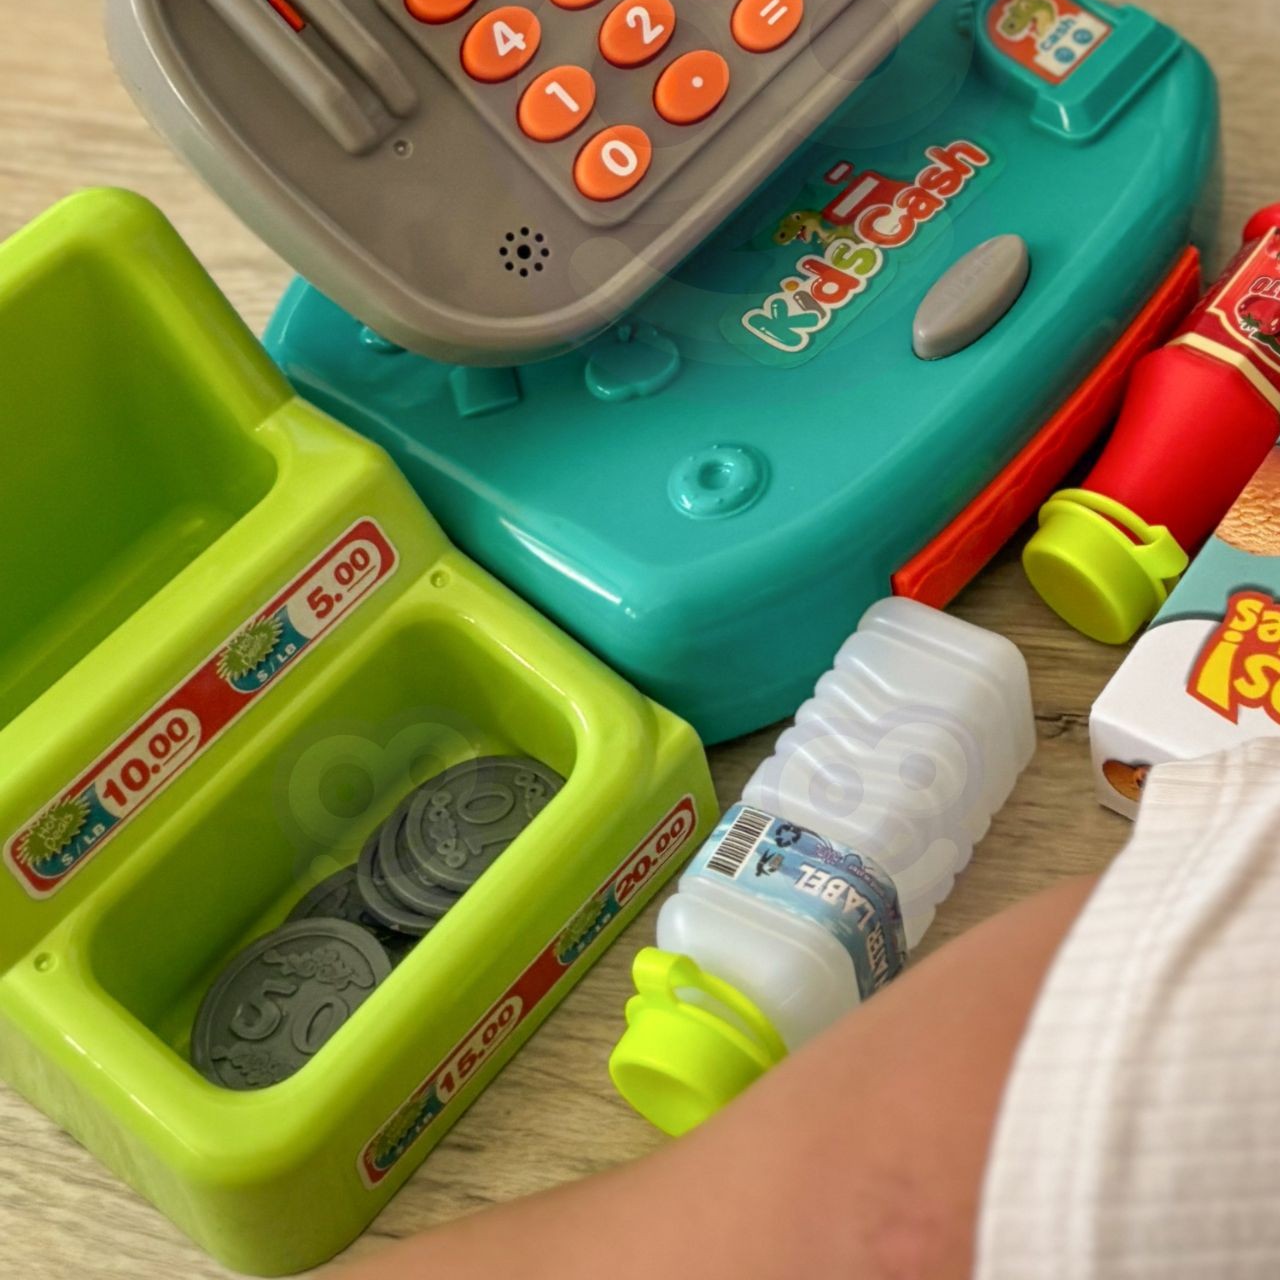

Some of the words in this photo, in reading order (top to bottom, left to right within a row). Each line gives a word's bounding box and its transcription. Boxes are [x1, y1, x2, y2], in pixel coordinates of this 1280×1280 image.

[492, 20, 527, 58] 4
[625, 6, 665, 46] 2
[1040, 19, 1077, 51] cash
[544, 81, 580, 113] 1
[600, 139, 638, 178] 0
[306, 547, 370, 620] 5.00
[102, 716, 189, 808] 10.00
[615, 816, 685, 904] 20.00
[794, 863, 876, 932] LABEL
[439, 1003, 515, 1094] 15.00
